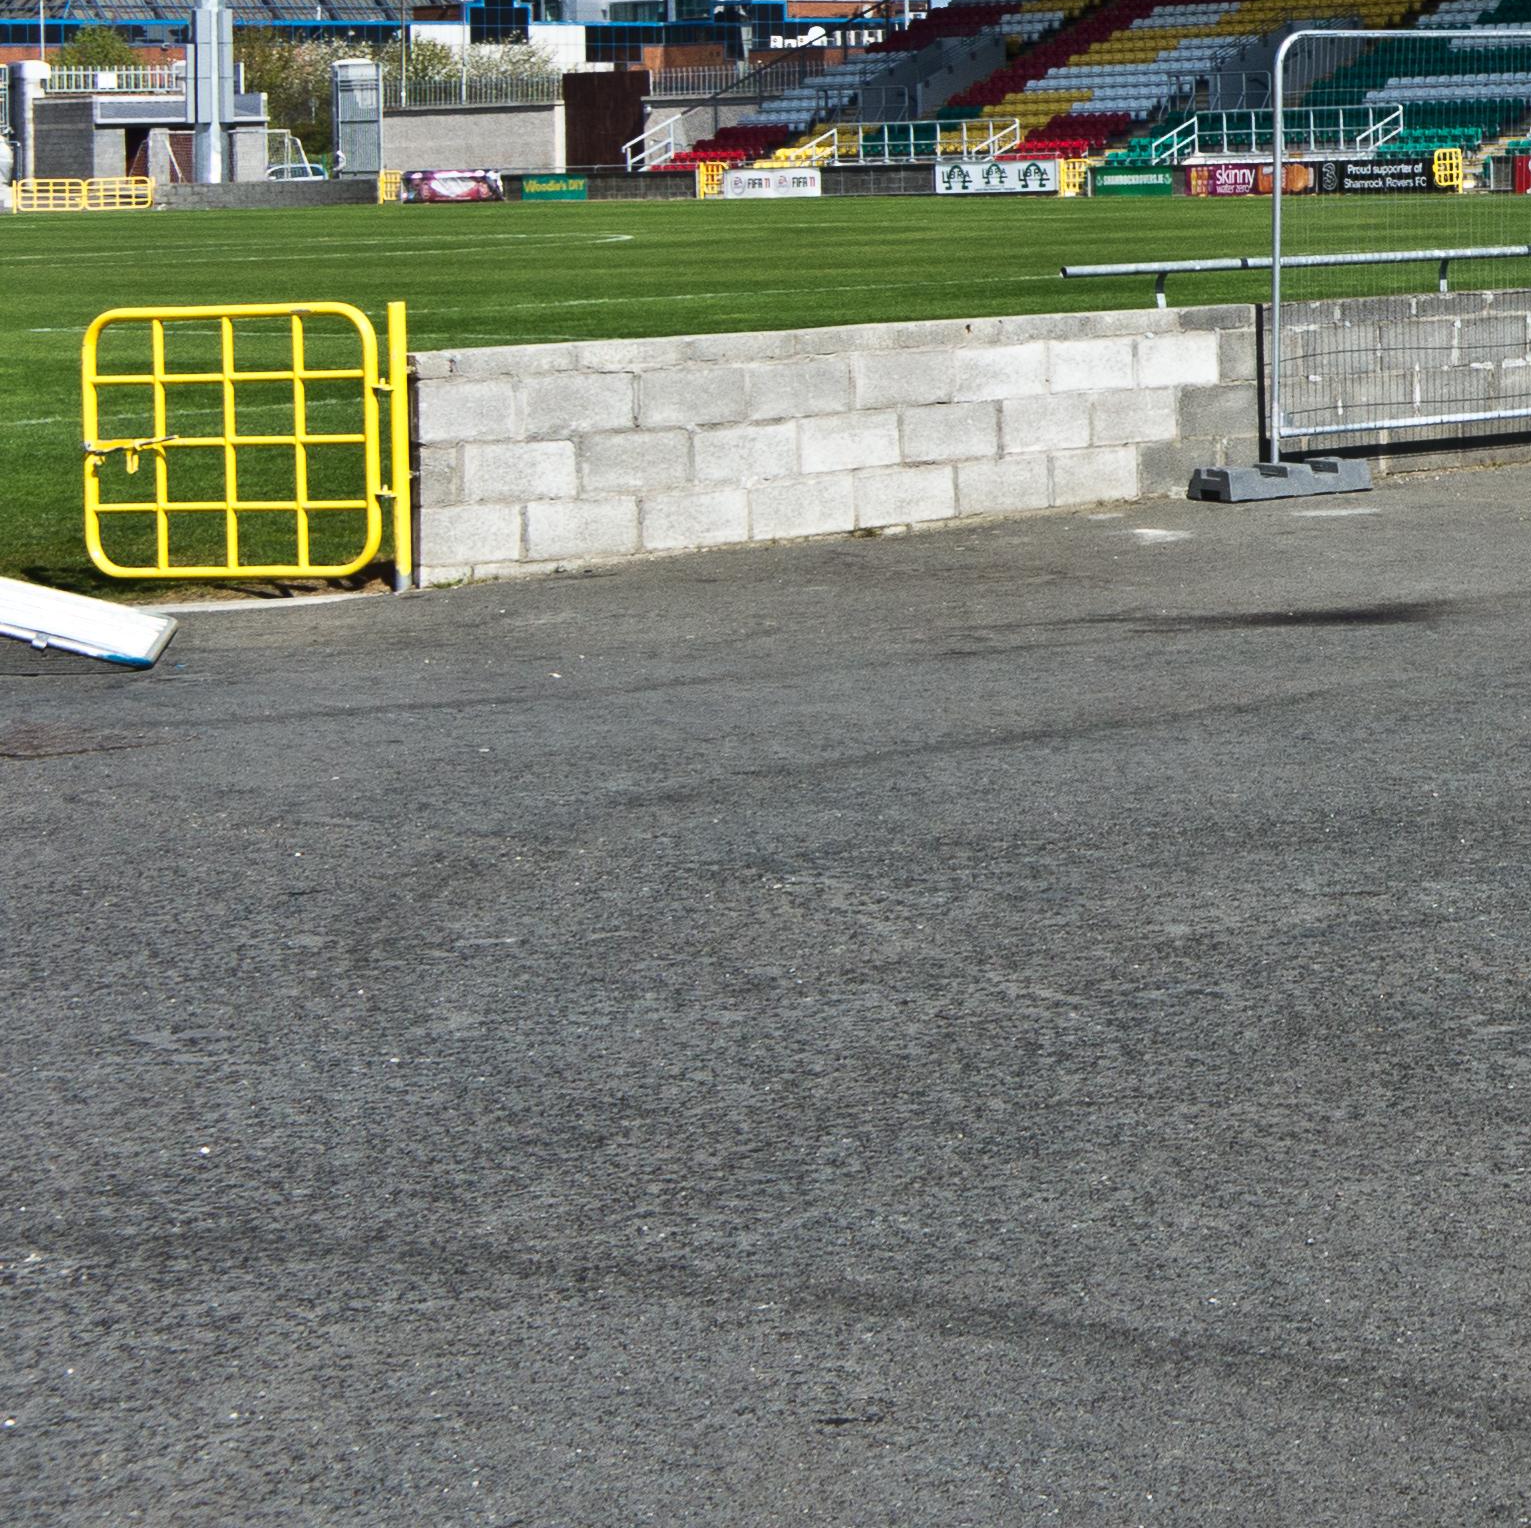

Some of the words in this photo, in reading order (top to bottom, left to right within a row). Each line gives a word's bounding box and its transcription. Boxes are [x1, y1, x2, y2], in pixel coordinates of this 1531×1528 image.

[1347, 164, 1371, 174] Proud
[1373, 164, 1412, 176] supporter
[1414, 163, 1423, 173] of
[747, 178, 763, 189] FIFA
[792, 176, 808, 188] FIFA
[1216, 165, 1256, 192] skinny
[1344, 177, 1382, 189] Shamrock
[1386, 177, 1413, 187] Rovers
[1415, 176, 1427, 186] FC
[1216, 185, 1235, 193] water
[1235, 183, 1249, 192] zero
